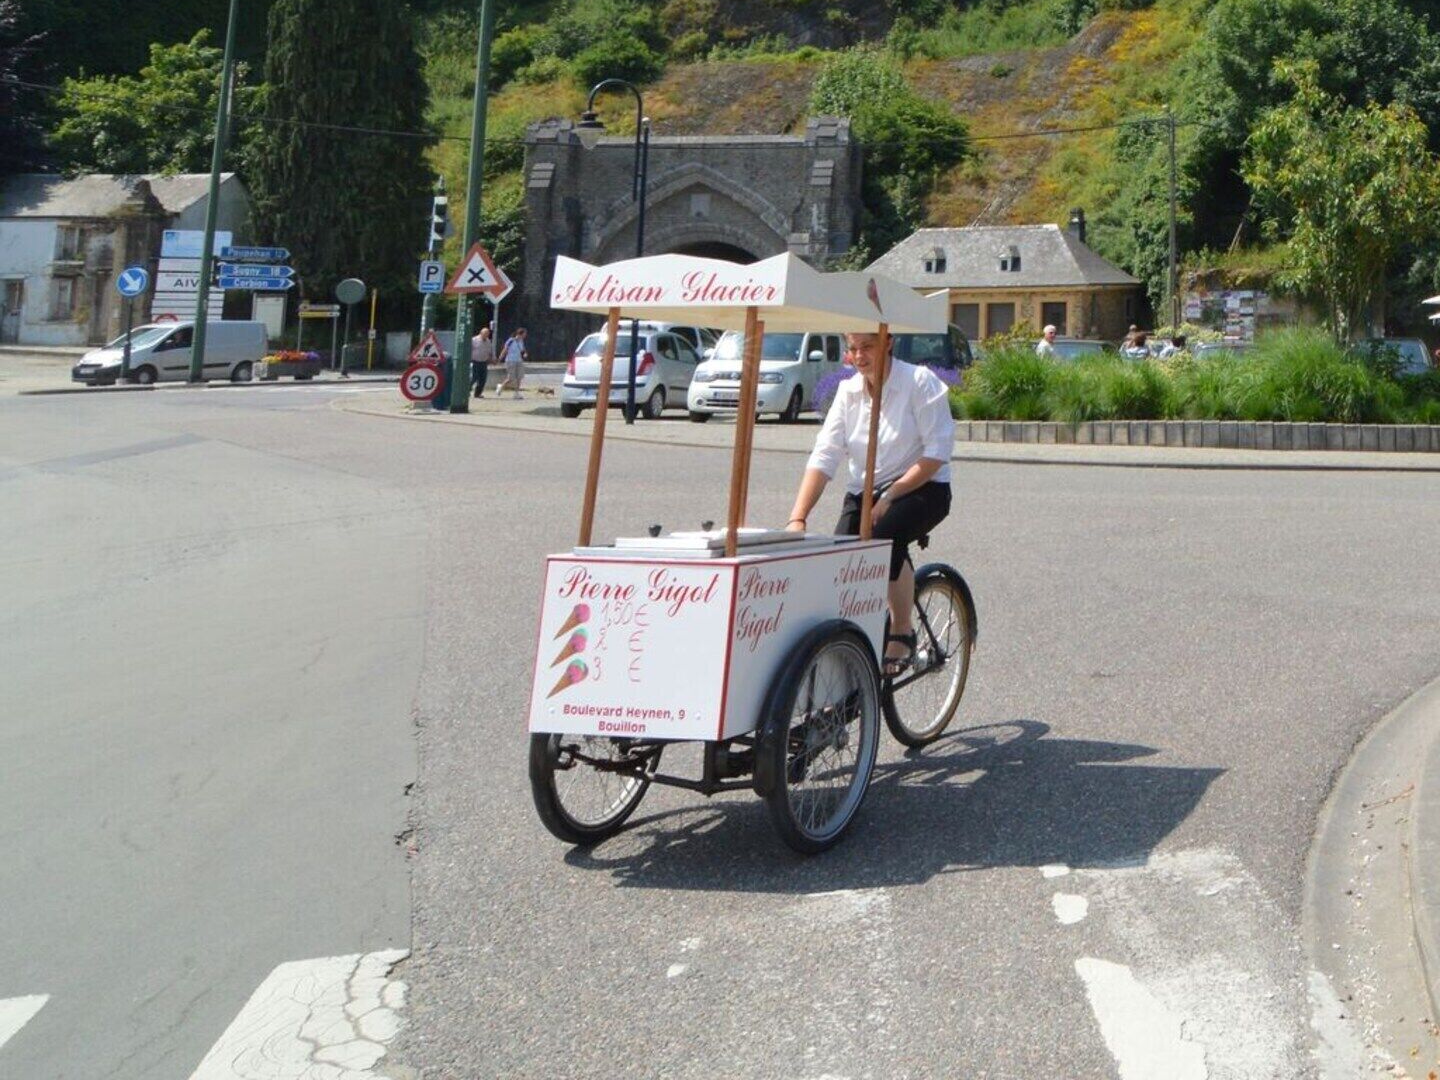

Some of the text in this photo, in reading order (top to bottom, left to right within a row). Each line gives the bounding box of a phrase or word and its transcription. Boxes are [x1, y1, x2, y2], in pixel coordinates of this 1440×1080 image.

[234, 278, 269, 287] Corbion
[426, 266, 439, 281] P
[555, 270, 780, 303] Artisan Glacier
[410, 375, 435, 391] 30
[739, 567, 791, 602] Pierre
[833, 553, 887, 587] Artisan
[558, 565, 720, 618] Pierre Gigot
[838, 588, 884, 619] Glacier
[736, 602, 785, 653] Gigot
[563, 704, 686, 722] Boulevard Heynen, 9
[598, 721, 647, 734] Bouillon
